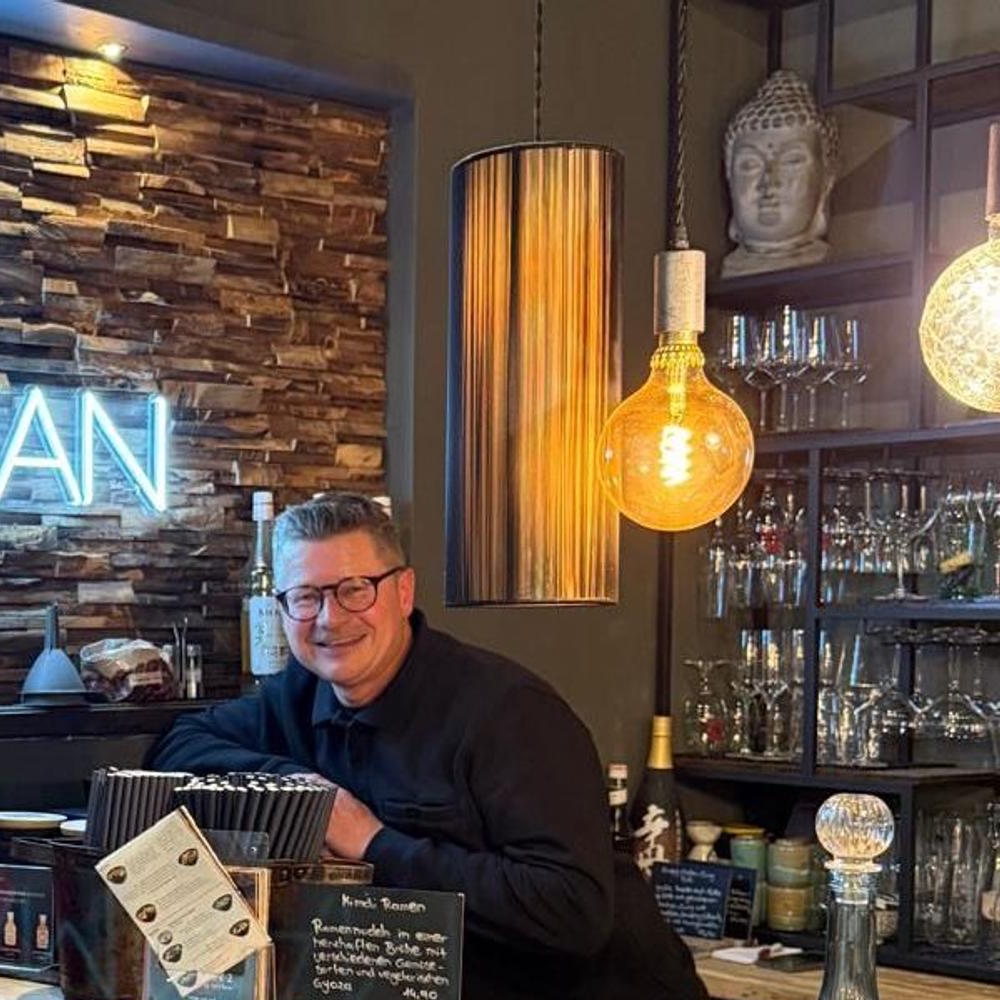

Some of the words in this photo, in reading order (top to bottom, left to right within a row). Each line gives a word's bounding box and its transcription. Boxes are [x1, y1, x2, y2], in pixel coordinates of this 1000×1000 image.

[380, 897, 426, 913] Ramen
[398, 929, 410, 941] in
[425, 946, 447, 959] mit
[355, 967, 375, 978] und
[313, 978, 352, 995] Gyoza
